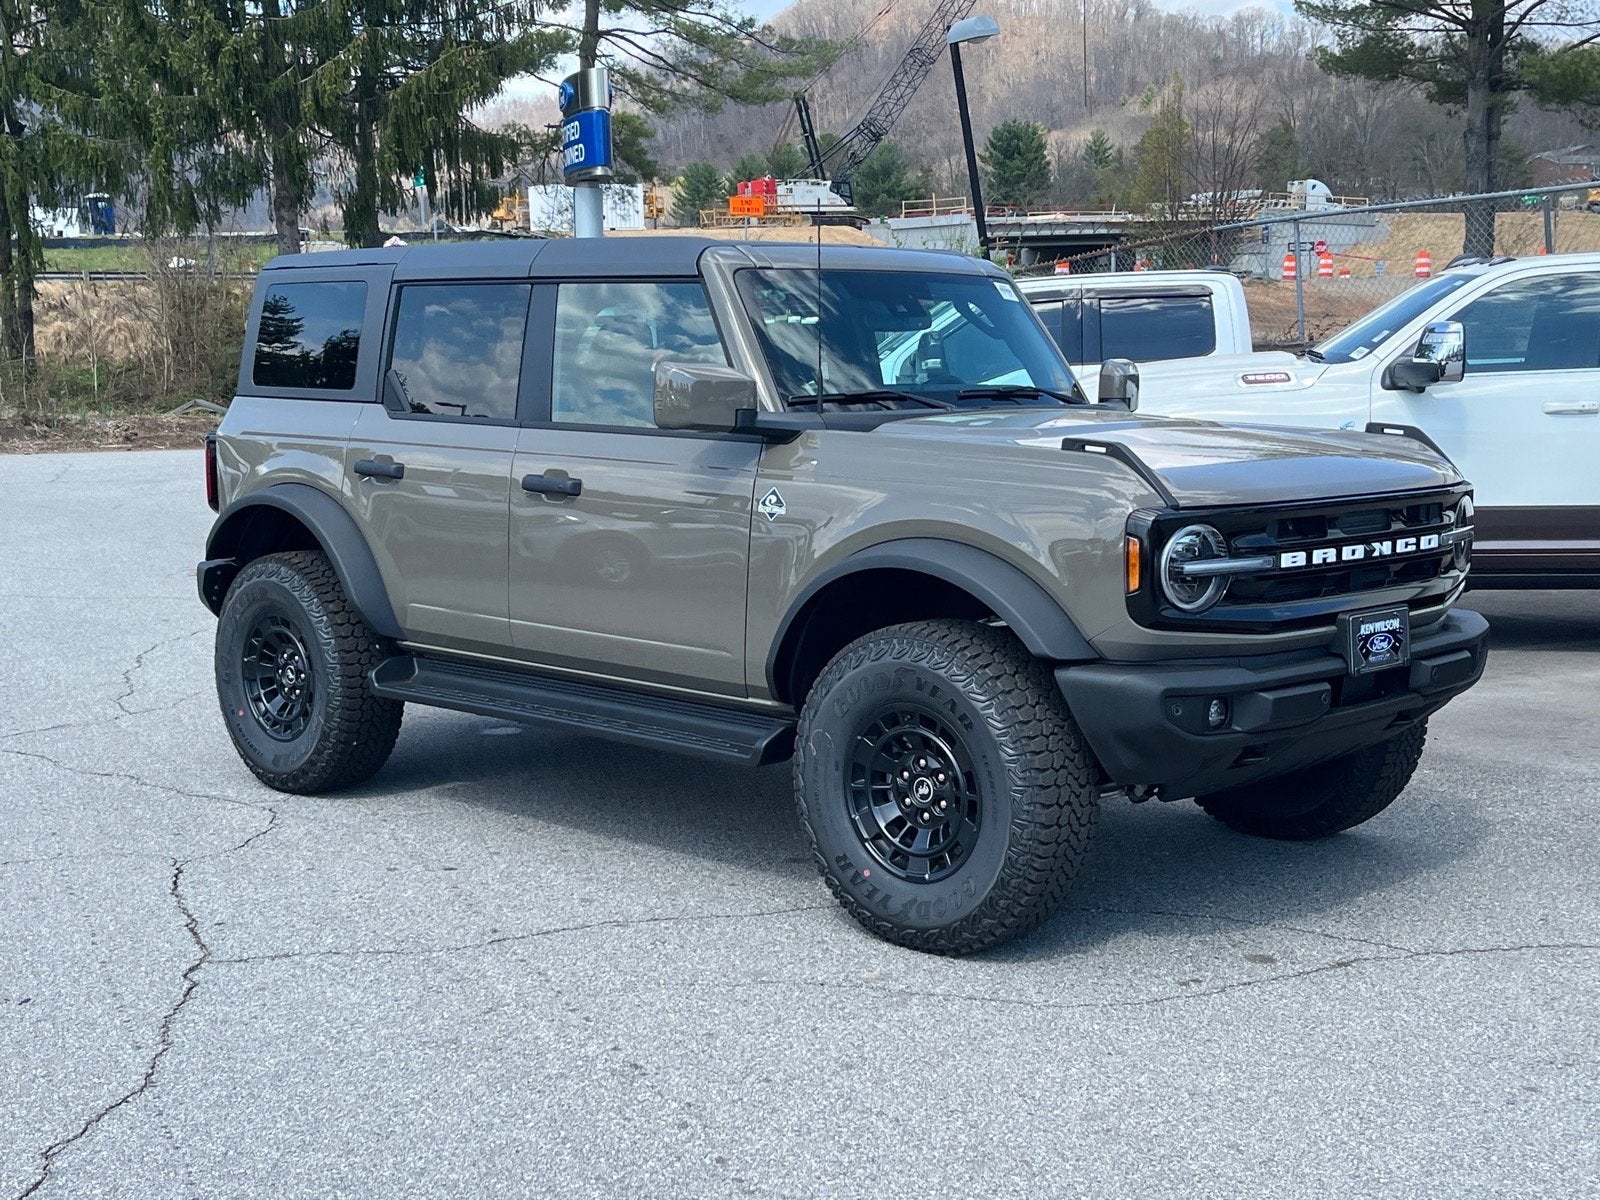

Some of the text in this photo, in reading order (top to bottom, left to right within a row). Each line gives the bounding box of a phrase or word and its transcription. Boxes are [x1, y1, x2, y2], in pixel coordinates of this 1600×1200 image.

[1281, 534, 1439, 568] BRONCO
[1360, 618, 1400, 635] KEN WILSON
[1373, 636, 1389, 650] Ford
